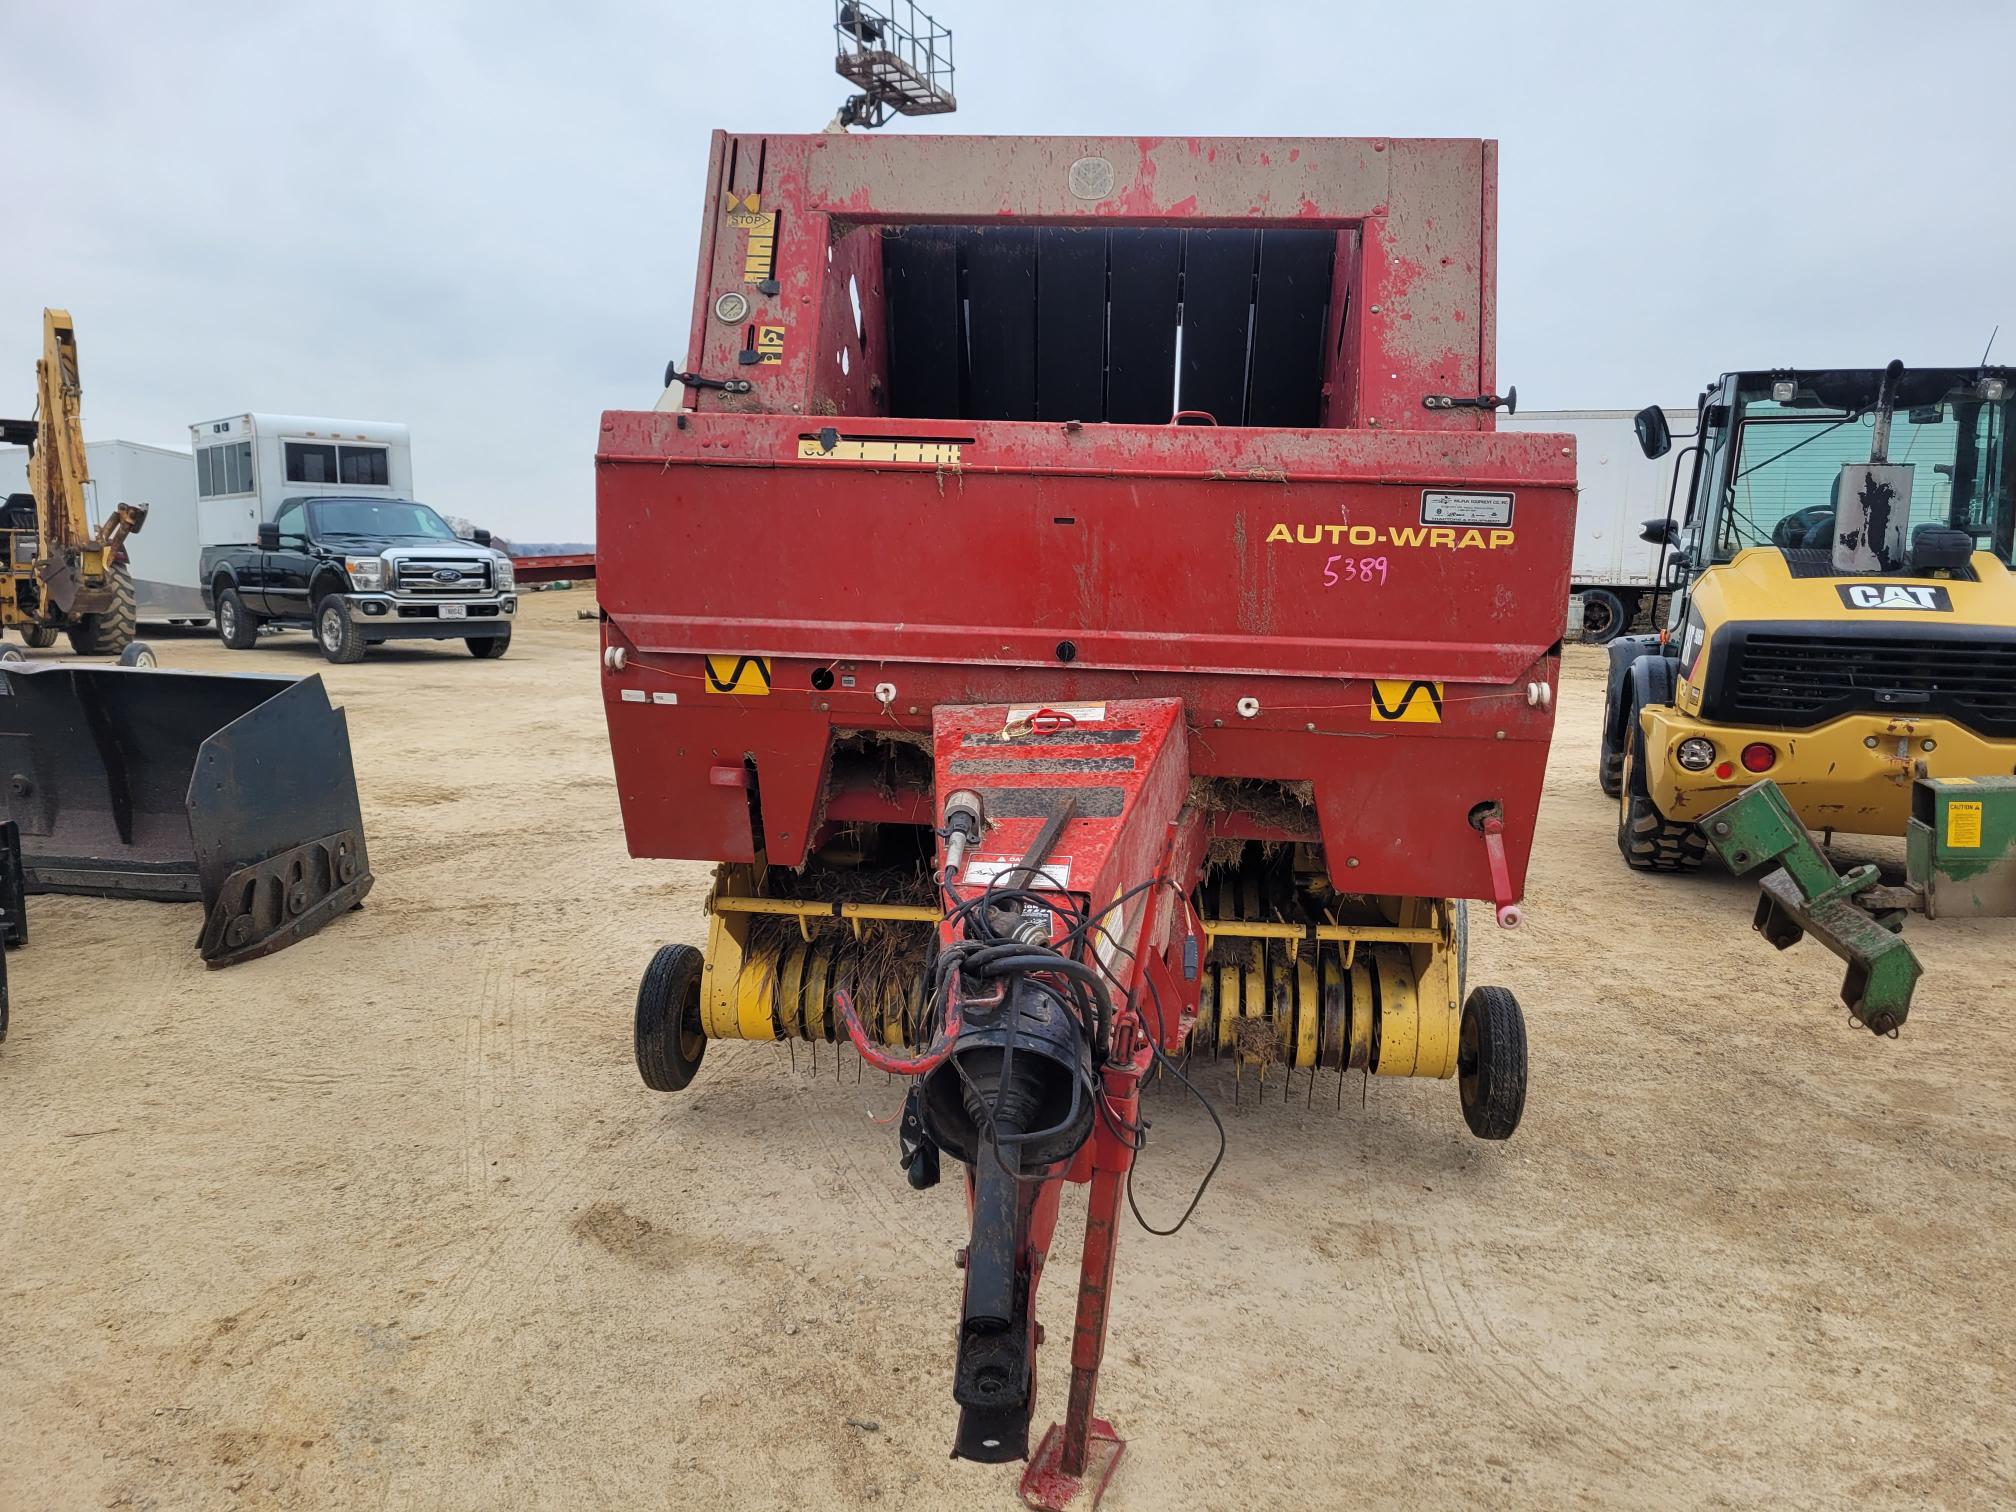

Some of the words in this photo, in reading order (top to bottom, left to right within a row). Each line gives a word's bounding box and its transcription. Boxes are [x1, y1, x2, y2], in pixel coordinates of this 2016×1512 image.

[731, 215, 761, 224] STOP
[1265, 523, 1515, 549] AUTO-WRAP
[1323, 555, 1388, 587] 5389
[1848, 586, 1937, 609] CAT
